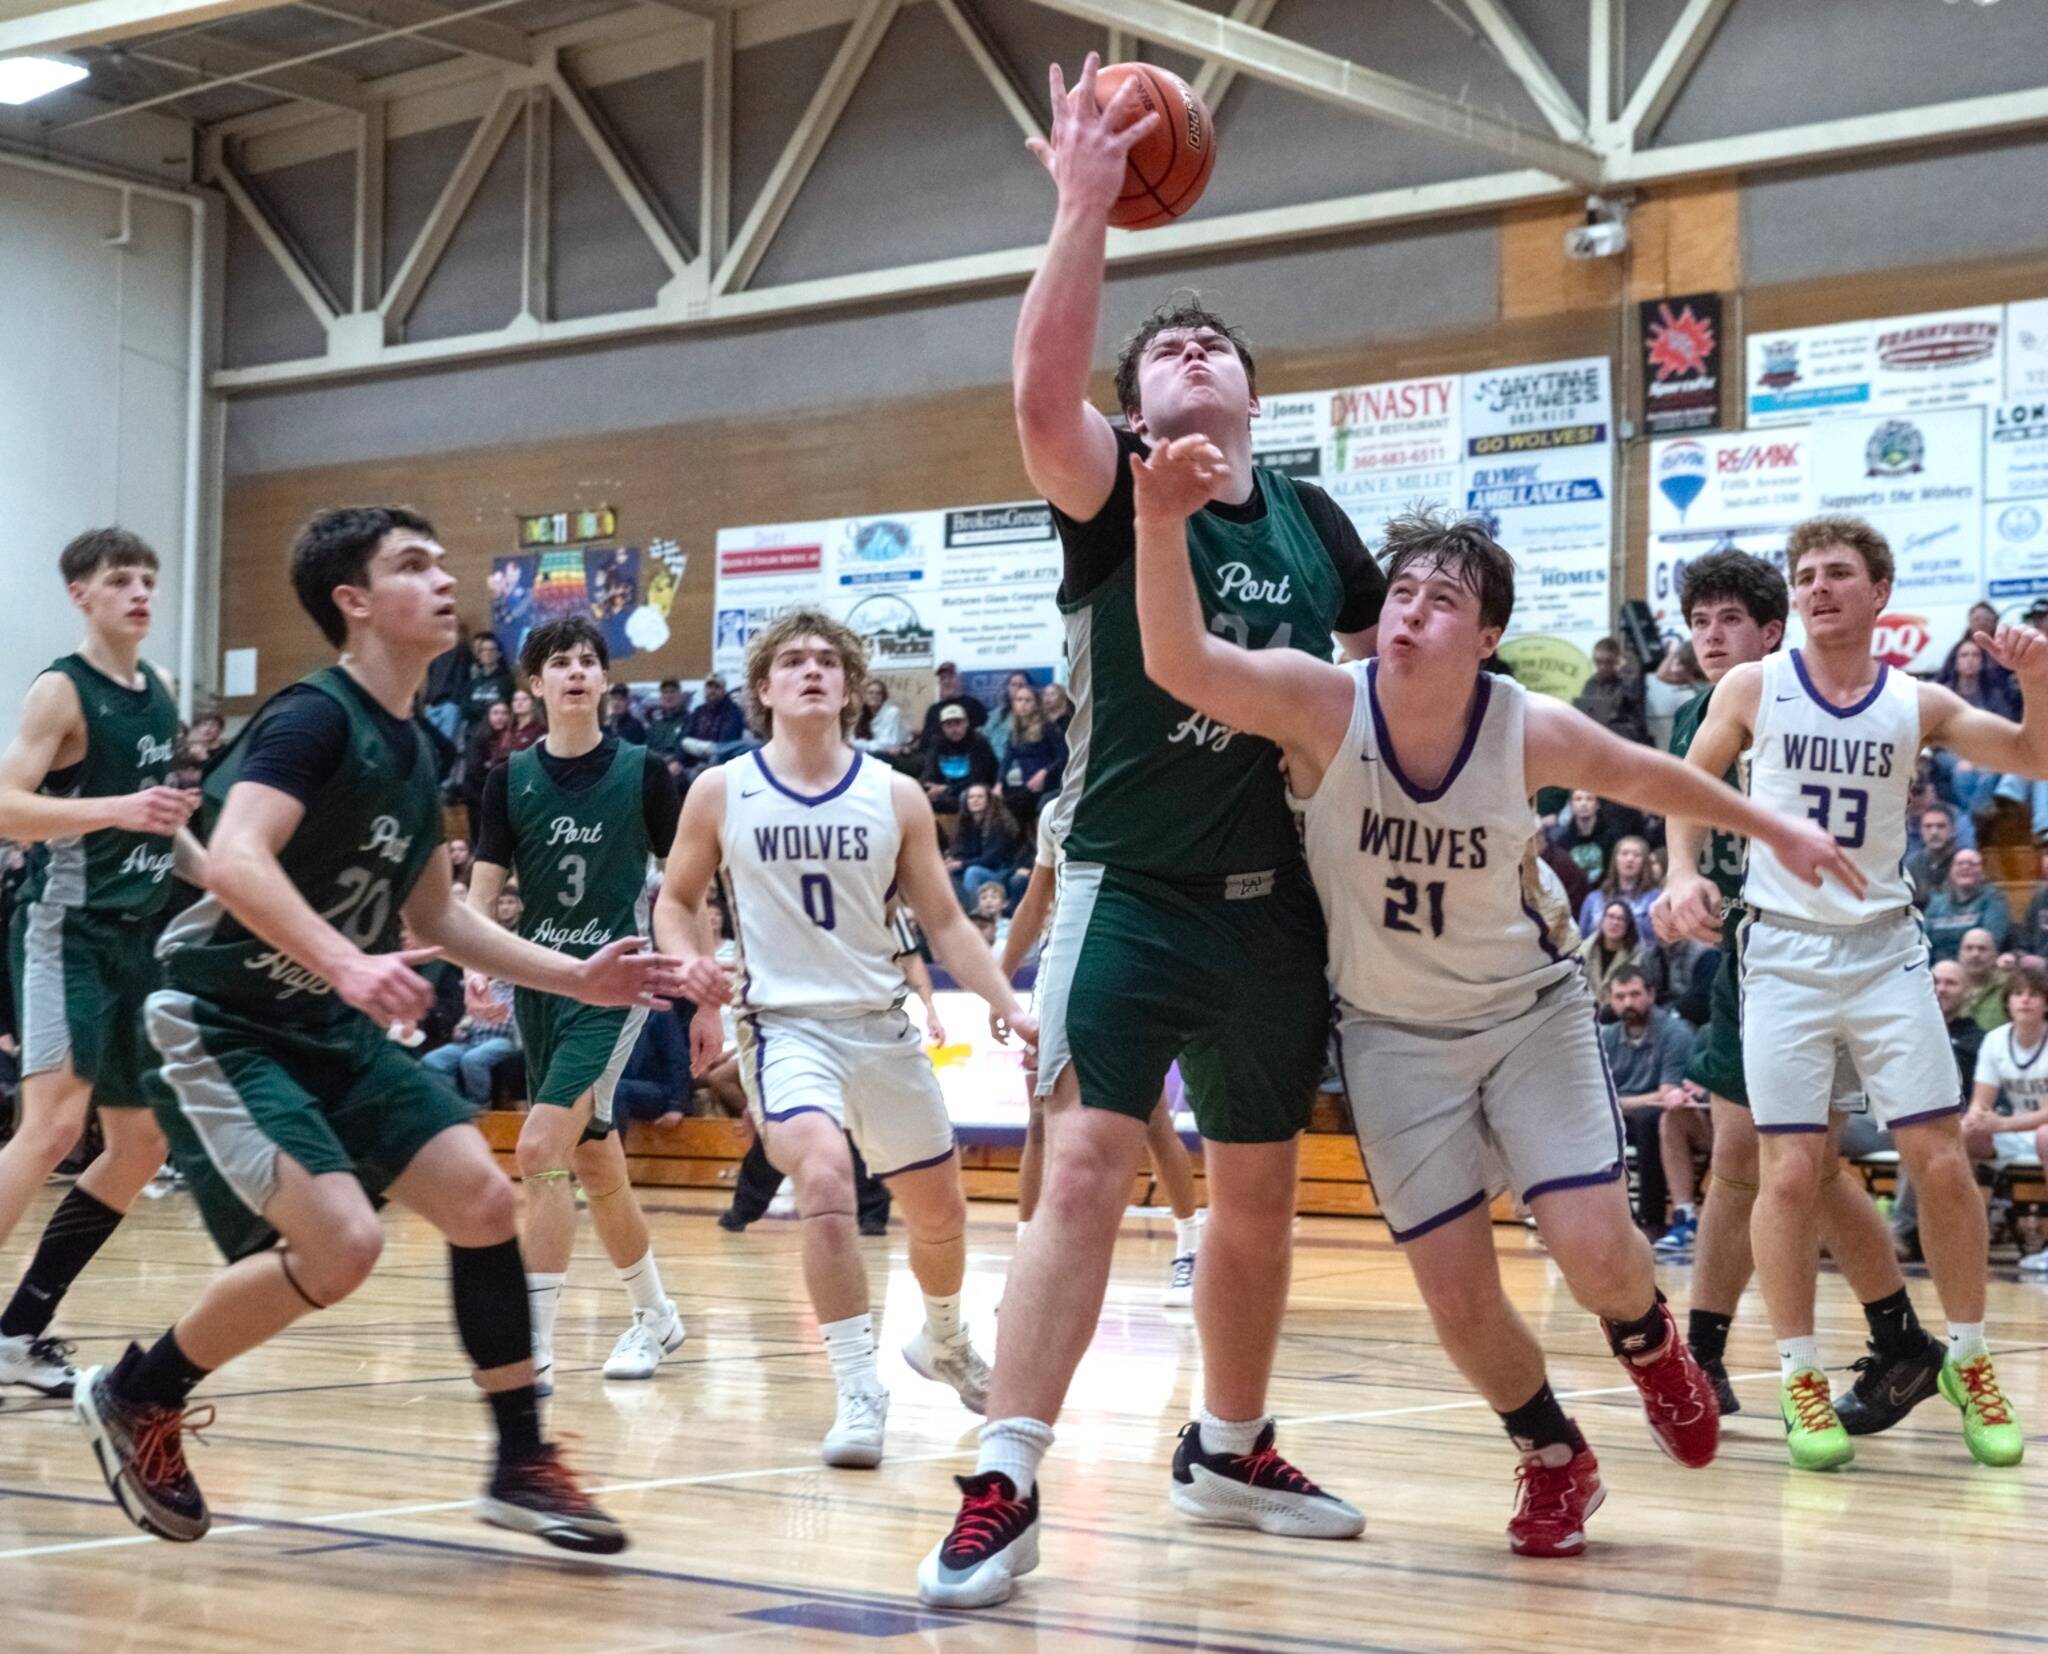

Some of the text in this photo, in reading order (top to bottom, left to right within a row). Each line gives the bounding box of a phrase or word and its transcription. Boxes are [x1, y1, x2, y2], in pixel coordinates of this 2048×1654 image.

[1330, 381, 1453, 427] DYNASTY
[1476, 427, 1598, 454] GO WOLVES!
[1717, 442, 1800, 473] RE/MAX
[1473, 463, 1541, 487] OLYMPIC
[1819, 486, 1973, 510] Supports the Wolves
[952, 508, 1050, 531] BrokersGroup
[1216, 561, 1292, 605] Port
[1541, 569, 1605, 587] HOMES
[1871, 625, 1920, 656] DQ
[1784, 734, 1894, 778] WOLVES
[546, 816, 604, 846] Port
[1800, 784, 1869, 849] 33
[754, 825, 869, 863] WOLVES
[1359, 806, 1488, 870] WOLVES
[557, 854, 587, 907] 3
[322, 866, 393, 951] 20
[801, 872, 836, 931] 0
[1383, 875, 1446, 940] 21
